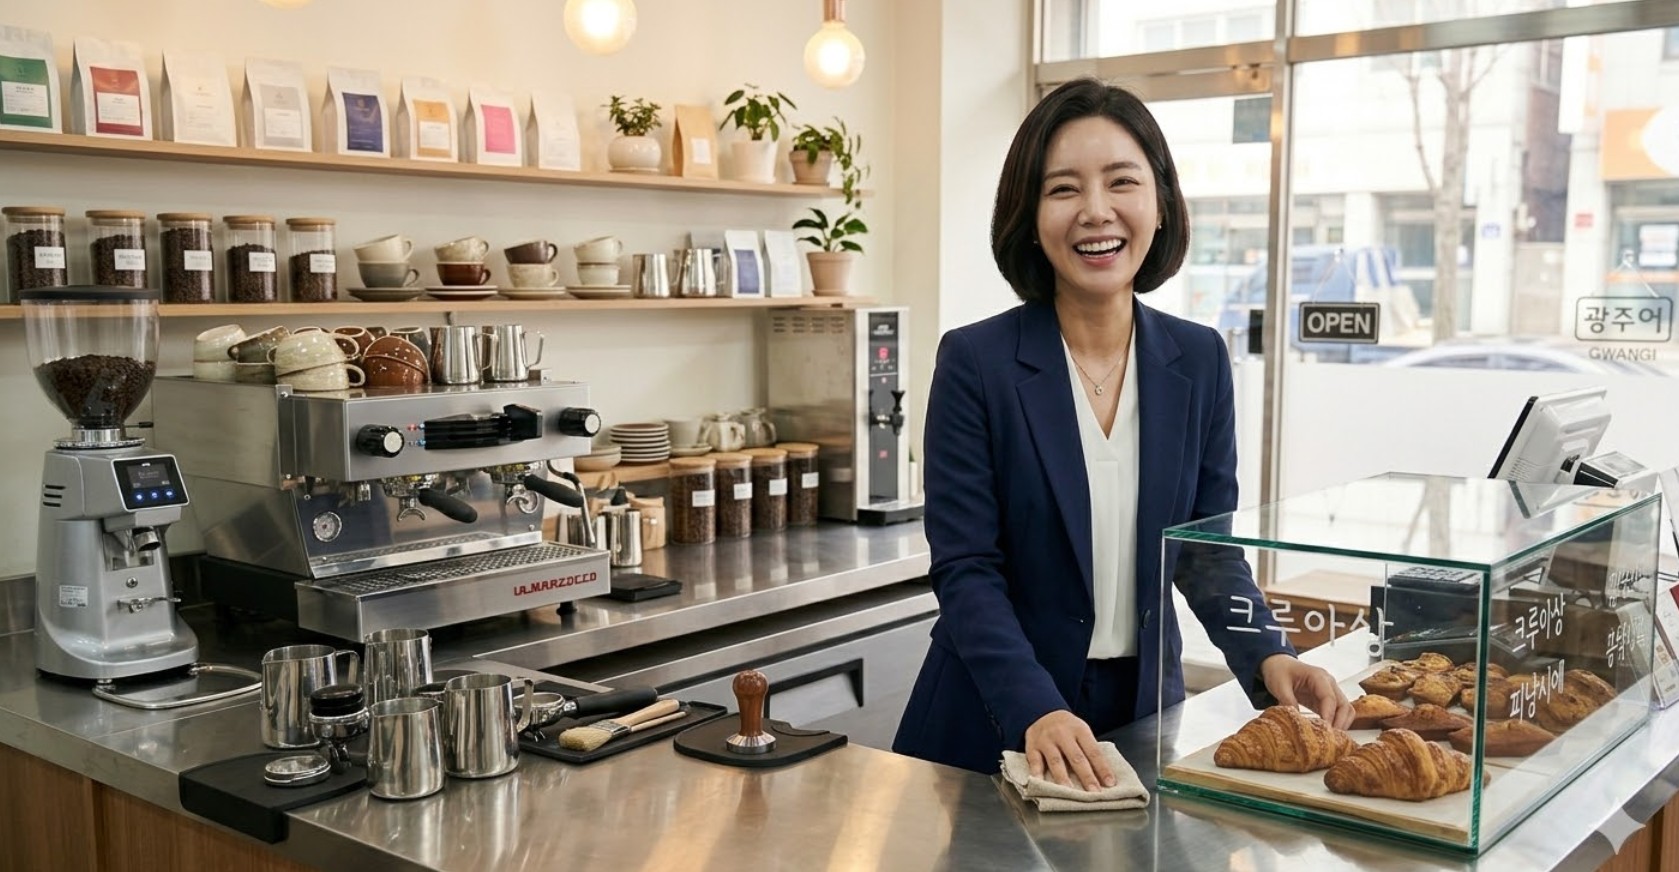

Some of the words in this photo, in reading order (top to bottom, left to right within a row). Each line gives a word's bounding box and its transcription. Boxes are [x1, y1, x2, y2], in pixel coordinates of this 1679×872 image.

[1307, 312, 1371, 334] OPEN
[1584, 307, 1662, 334] 광주어
[1226, 595, 1395, 657] 크루아상
[1509, 659, 1565, 723] 피낭시에
